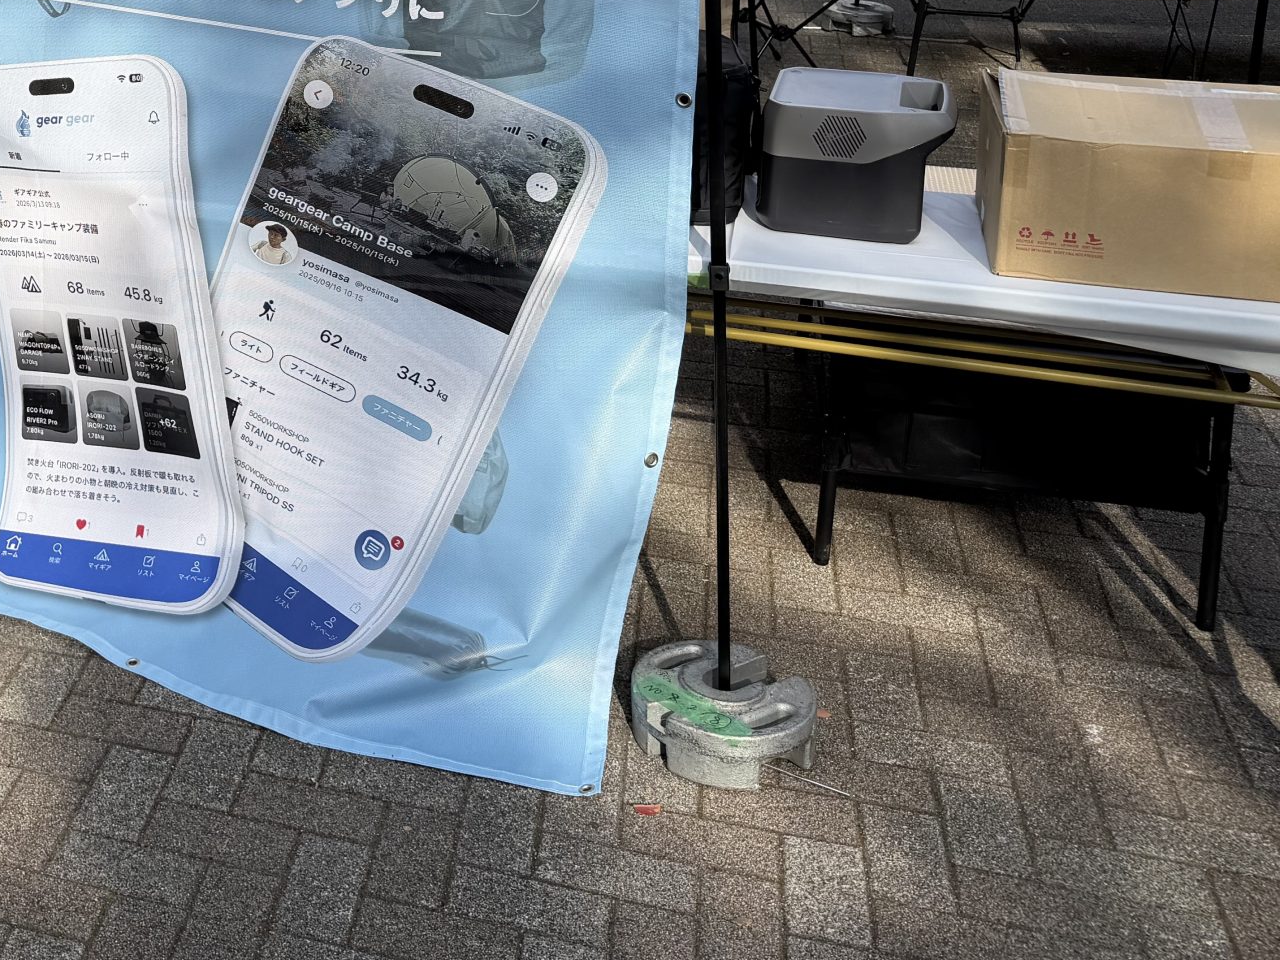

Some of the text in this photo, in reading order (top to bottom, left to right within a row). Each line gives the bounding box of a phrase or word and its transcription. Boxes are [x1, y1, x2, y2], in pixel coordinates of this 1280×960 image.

[339, 57, 370, 77] 12:20
[36, 113, 95, 128] gear gear
[86, 150, 130, 161] フォロー中
[269, 187, 414, 259] geargear Camp Base
[262, 202, 323, 236] 2025/10/15(水)
[335, 235, 400, 267] 2025/10/15(水)
[67, 281, 84, 295] 68
[298, 269, 342, 293] 2025/09/16
[302, 258, 400, 304] yosimasa @yosimasa
[124, 286, 163, 304] 45.8 kg
[240, 338, 262, 354] ライト
[319, 329, 343, 350] 62
[94, 355, 113, 363] STAND
[224, 366, 276, 397] ファニチャー
[290, 362, 346, 393] フィールドギア
[396, 365, 449, 402] 34.3 kg
[26, 406, 39, 414] ECO
[373, 402, 421, 431] ファニチャー
[26, 416, 47, 425] RIVER2
[159, 418, 177, 429] +62
[248, 409, 310, 443] 5050WORKSHOP
[240, 433, 255, 447] 80g
[244, 421, 326, 467] STAND HOOK SET
[249, 479, 280, 505] TRIPOD
[280, 500, 295, 512] SS
[27, 514, 34, 523] 3
[393, 540, 401, 548] 2
[1, 550, 18, 558] ホーム
[88, 562, 112, 571] マイギア
[137, 568, 155, 577] リスト
[178, 573, 210, 583] マイページ
[273, 594, 290, 610] リスト
[309, 620, 338, 641] マイページ
